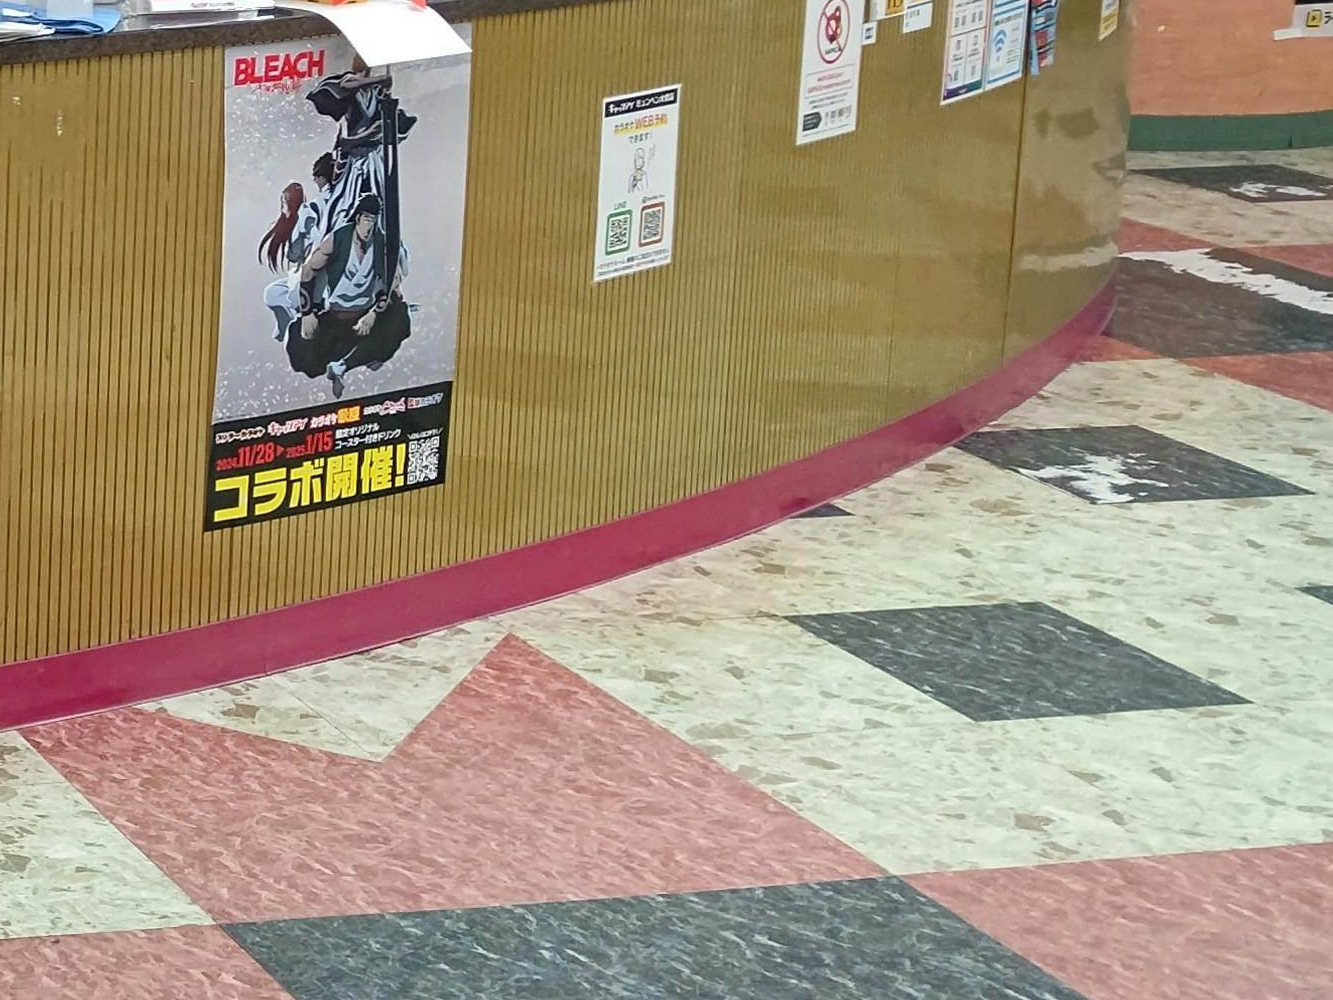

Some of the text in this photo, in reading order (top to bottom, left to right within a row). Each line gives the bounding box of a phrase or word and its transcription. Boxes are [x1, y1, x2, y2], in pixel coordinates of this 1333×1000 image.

[234, 49, 325, 86] BLEACH
[335, 429, 402, 450] コースター付きドリンク
[213, 443, 407, 523] コラボ開催!
